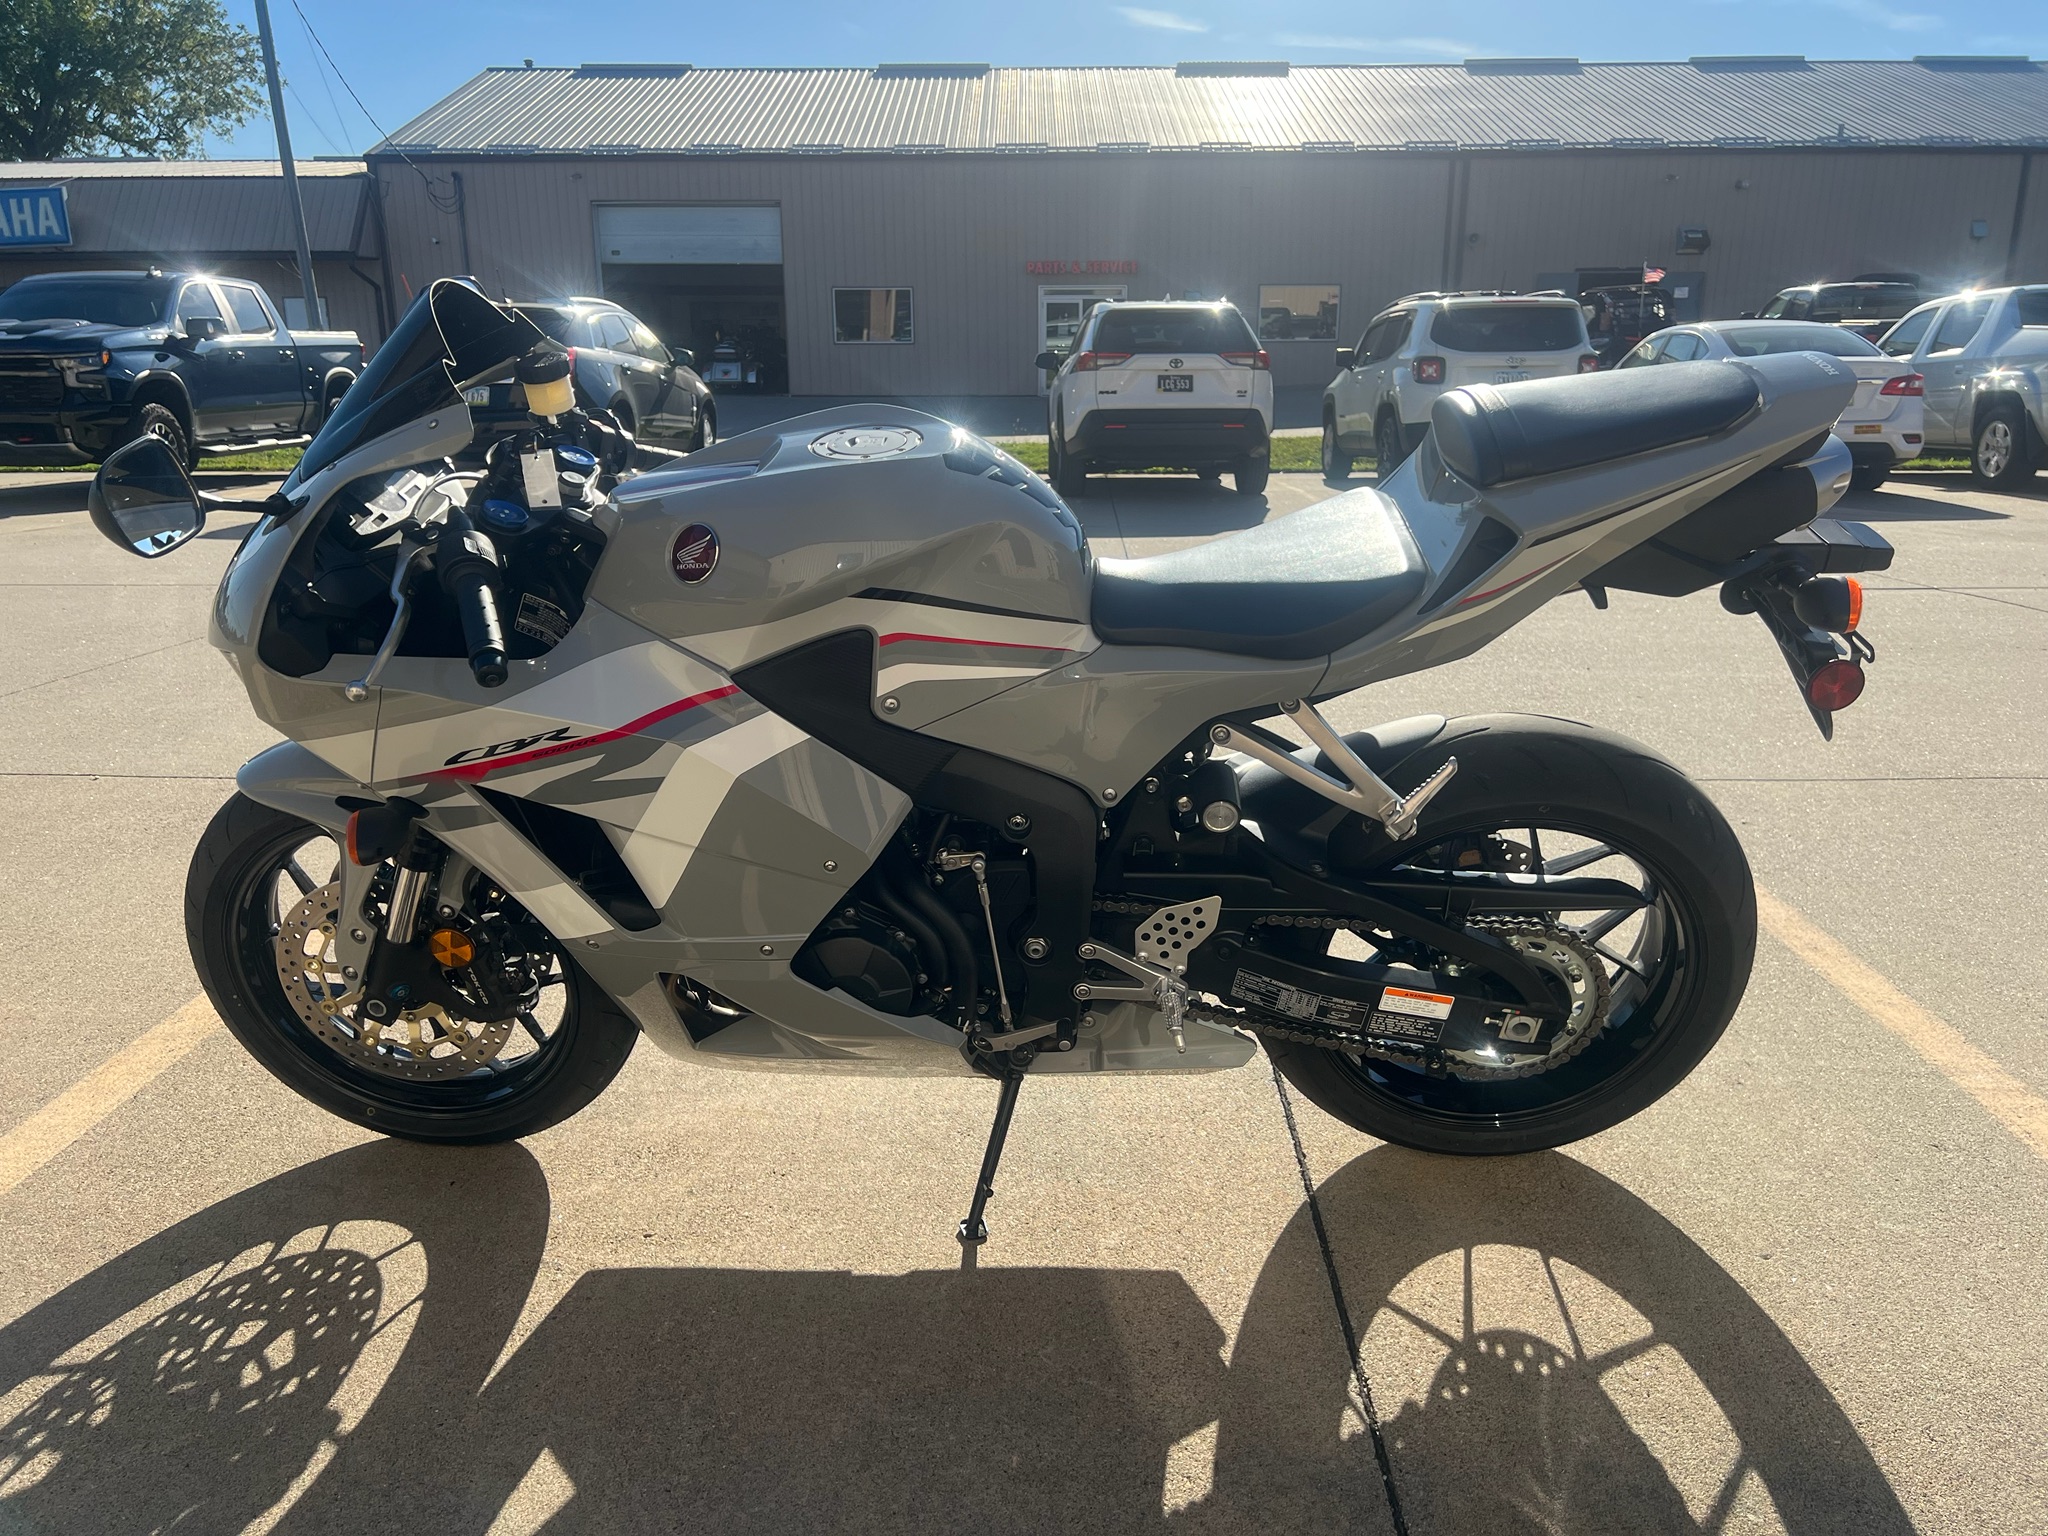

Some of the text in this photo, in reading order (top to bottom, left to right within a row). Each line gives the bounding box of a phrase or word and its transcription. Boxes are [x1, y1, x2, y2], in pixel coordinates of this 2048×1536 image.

[1026, 260, 1138, 274] PARTS & SERVICE
[676, 562, 710, 570] HONDA
[443, 726, 583, 767] CBR
[467, 967, 489, 1005] TOKICO
[1409, 992, 1434, 1001] WARNING
